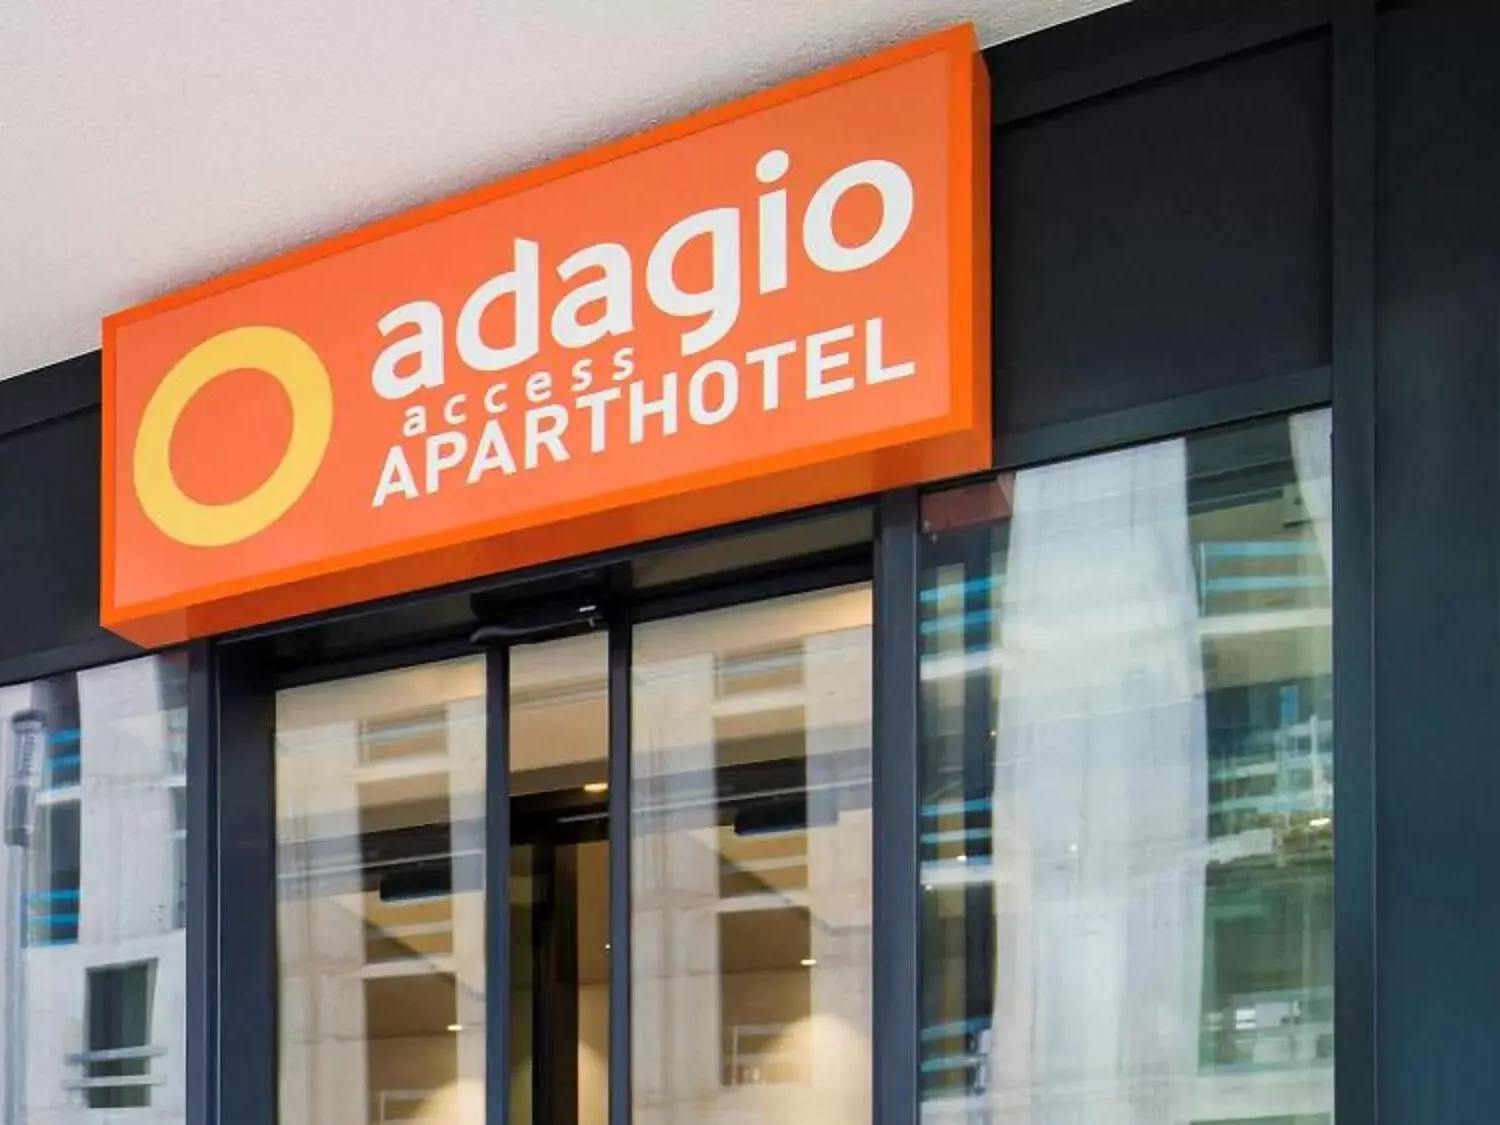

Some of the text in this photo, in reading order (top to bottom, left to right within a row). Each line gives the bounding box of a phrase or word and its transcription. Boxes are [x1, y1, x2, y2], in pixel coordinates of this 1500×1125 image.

[371, 149, 914, 400] adagio
[372, 317, 916, 508] APARTHOTEL
[403, 347, 635, 437] access
